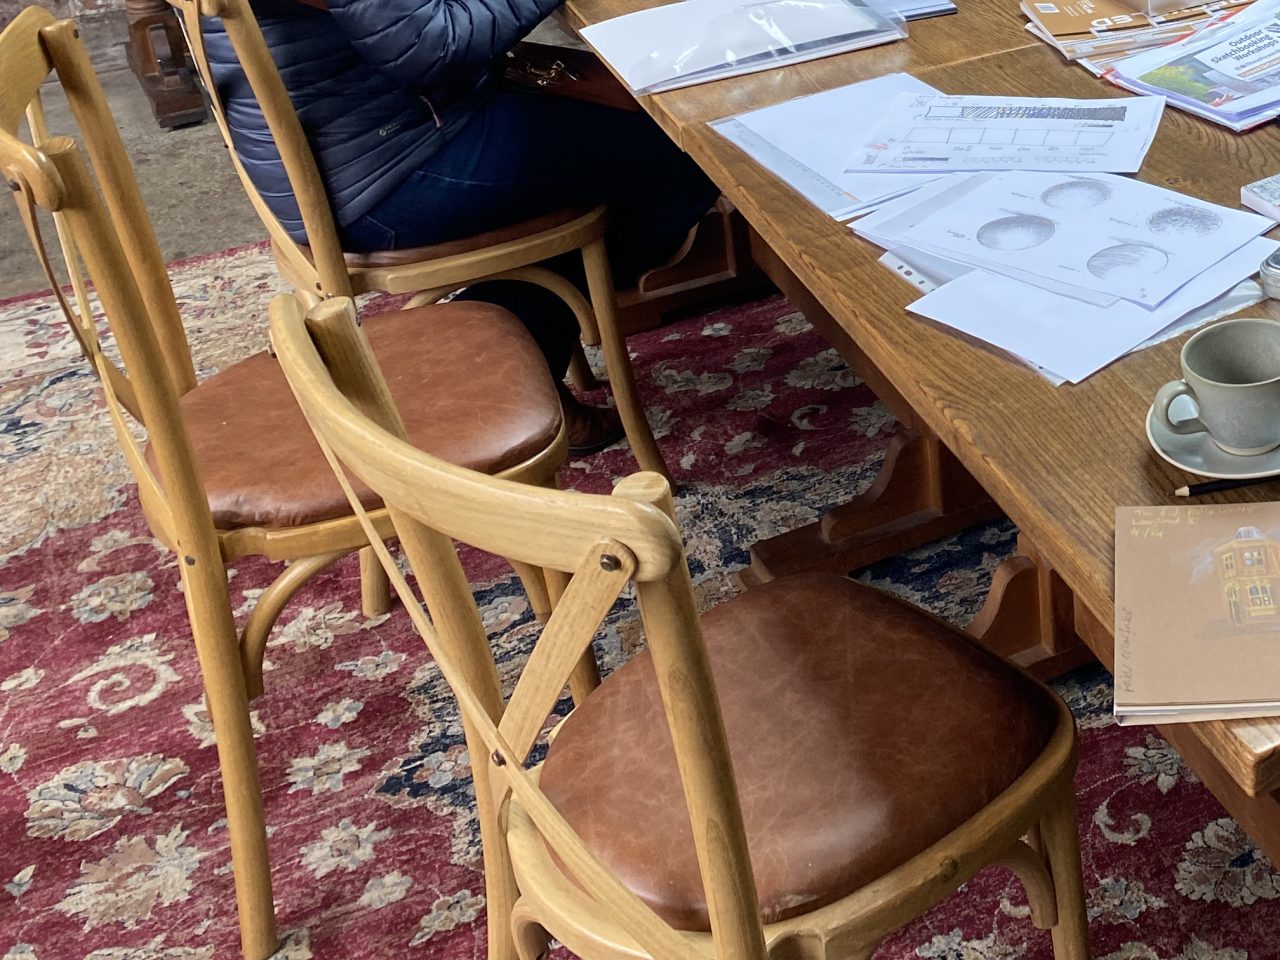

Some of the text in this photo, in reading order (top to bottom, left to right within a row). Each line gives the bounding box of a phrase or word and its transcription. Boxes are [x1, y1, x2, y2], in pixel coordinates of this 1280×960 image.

[1211, 34, 1273, 64] Sketchbooking
[1229, 29, 1263, 47] Outdoor
[1233, 39, 1280, 61] Workshops
